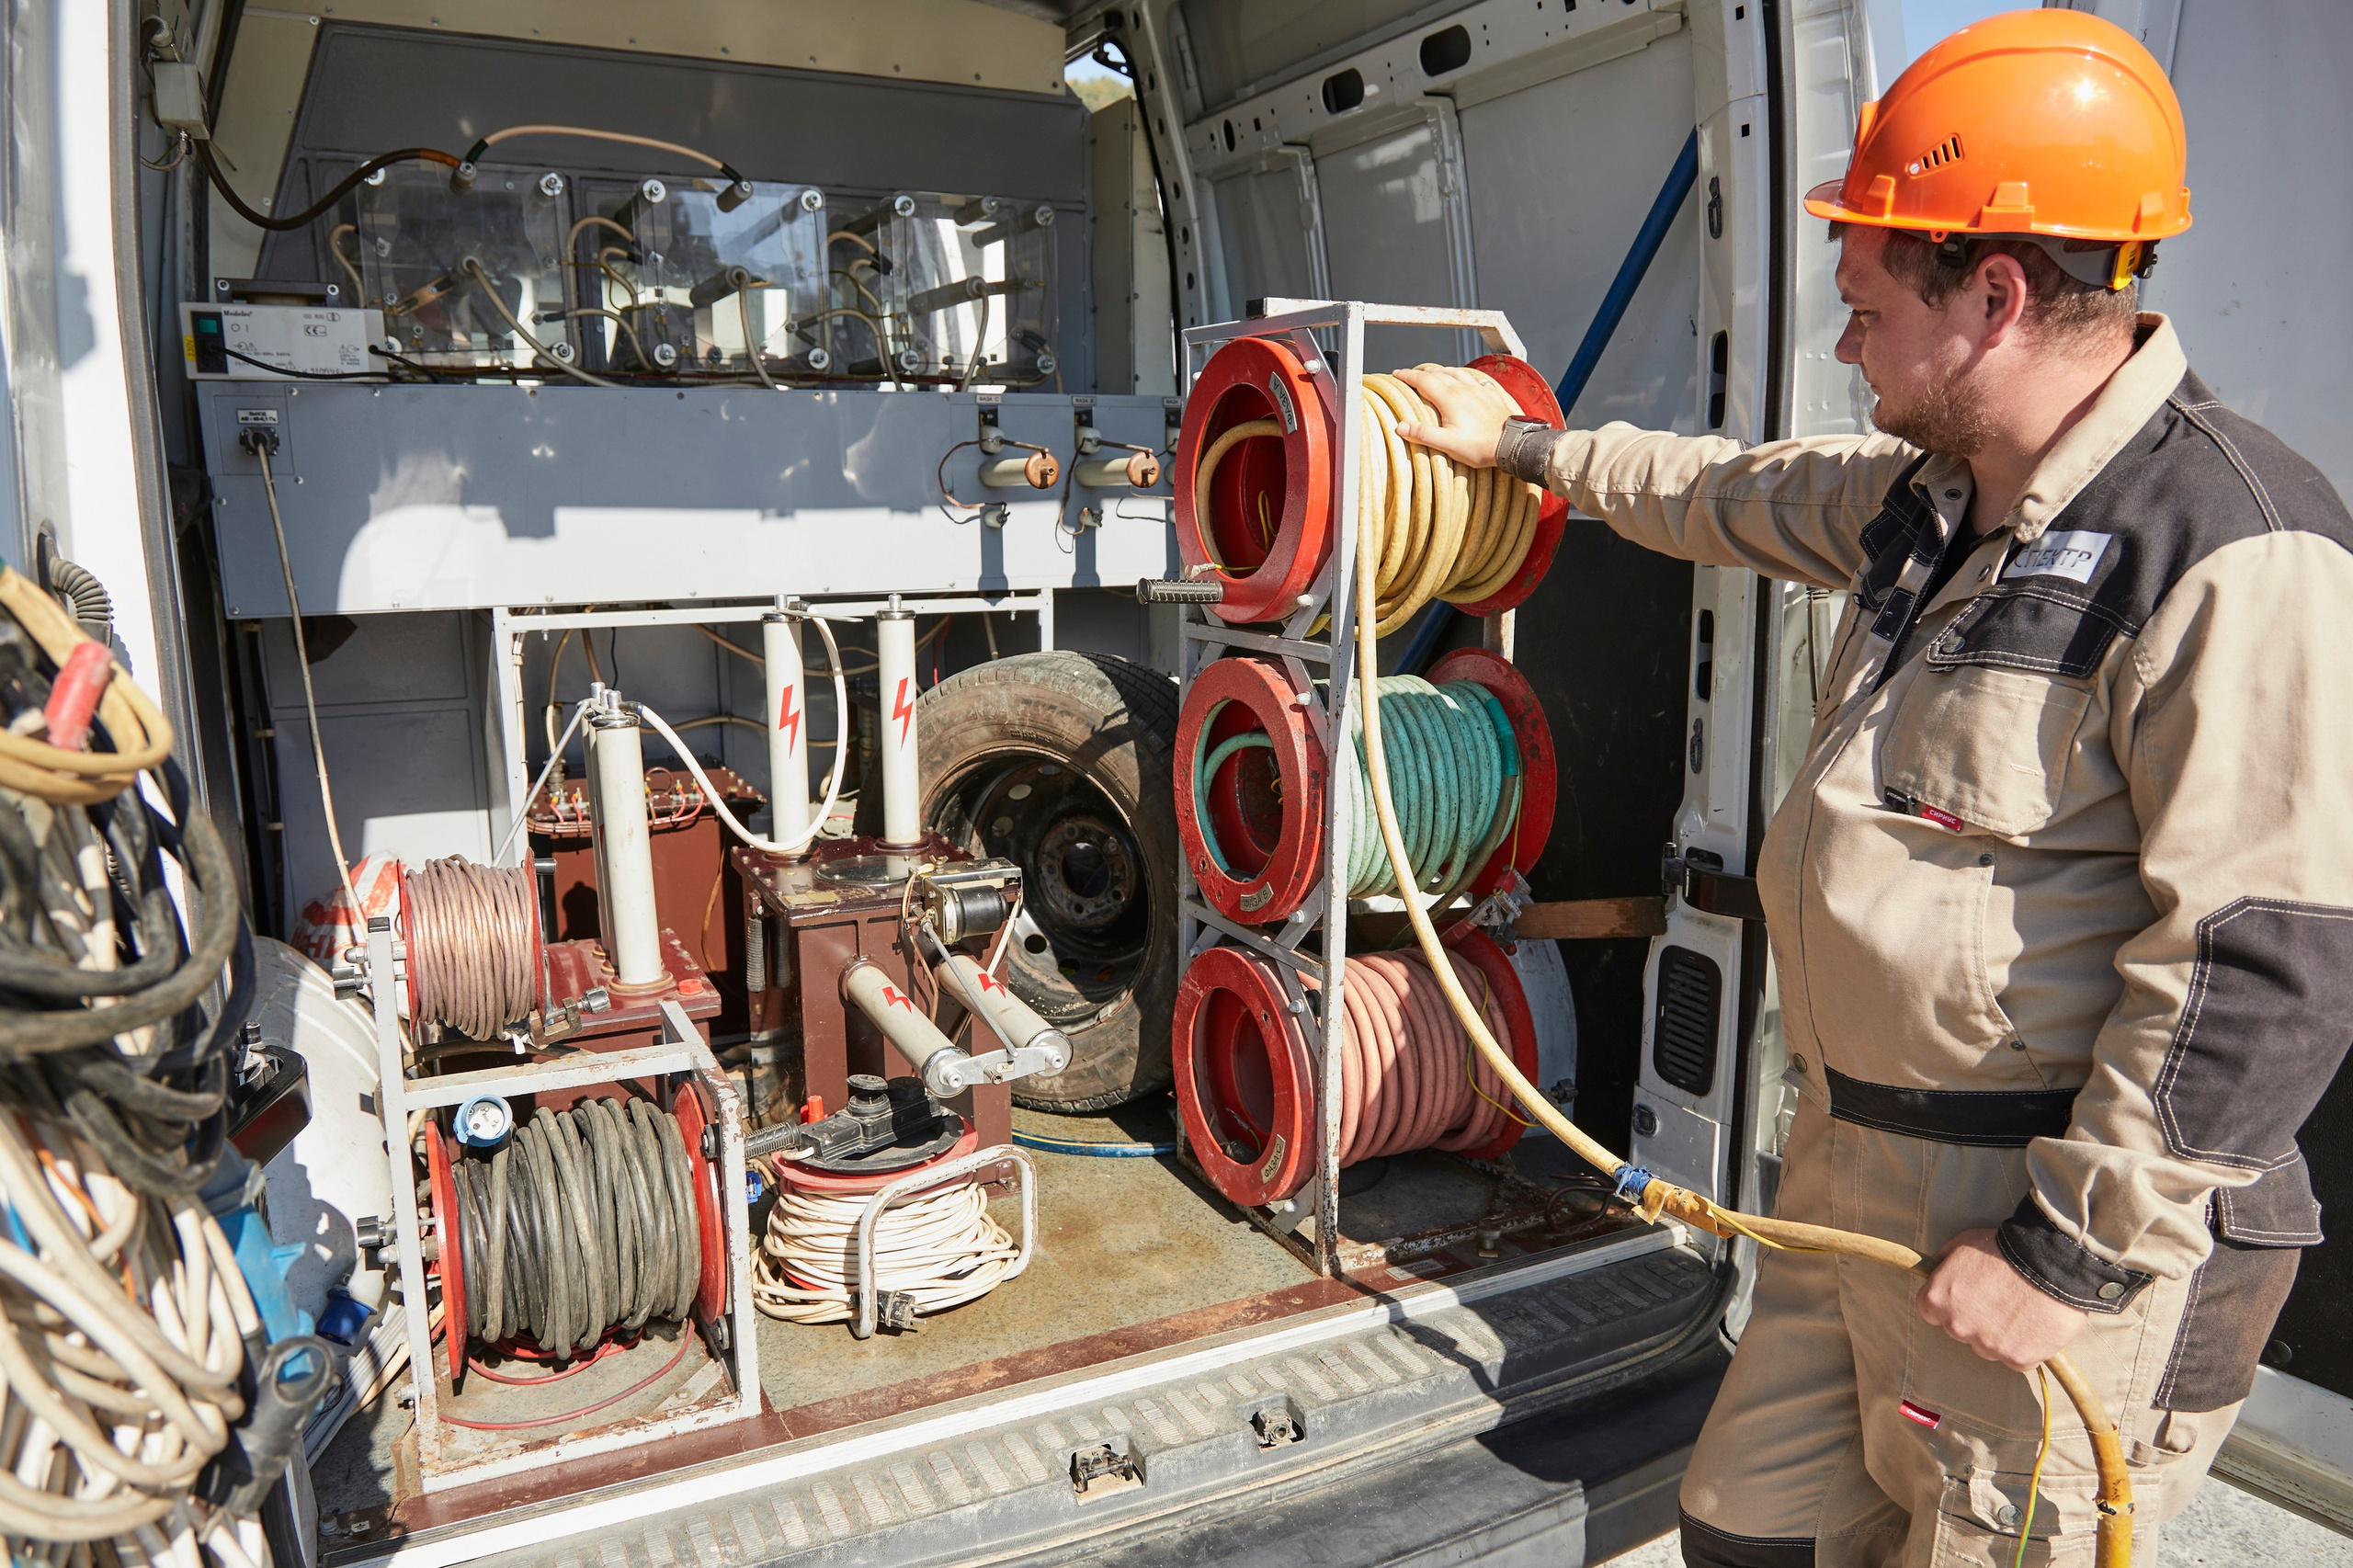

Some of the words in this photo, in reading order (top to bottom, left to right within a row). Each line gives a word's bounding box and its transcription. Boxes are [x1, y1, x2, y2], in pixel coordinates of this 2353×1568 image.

[1279, 388, 1292, 425] ФАЗА
[2015, 548, 2093, 568] СПЕКТР
[1929, 809, 1957, 824] СИРИУС
[1245, 895, 1262, 907] ФАЗА
[1264, 1154, 1279, 1177] ФАЗА
